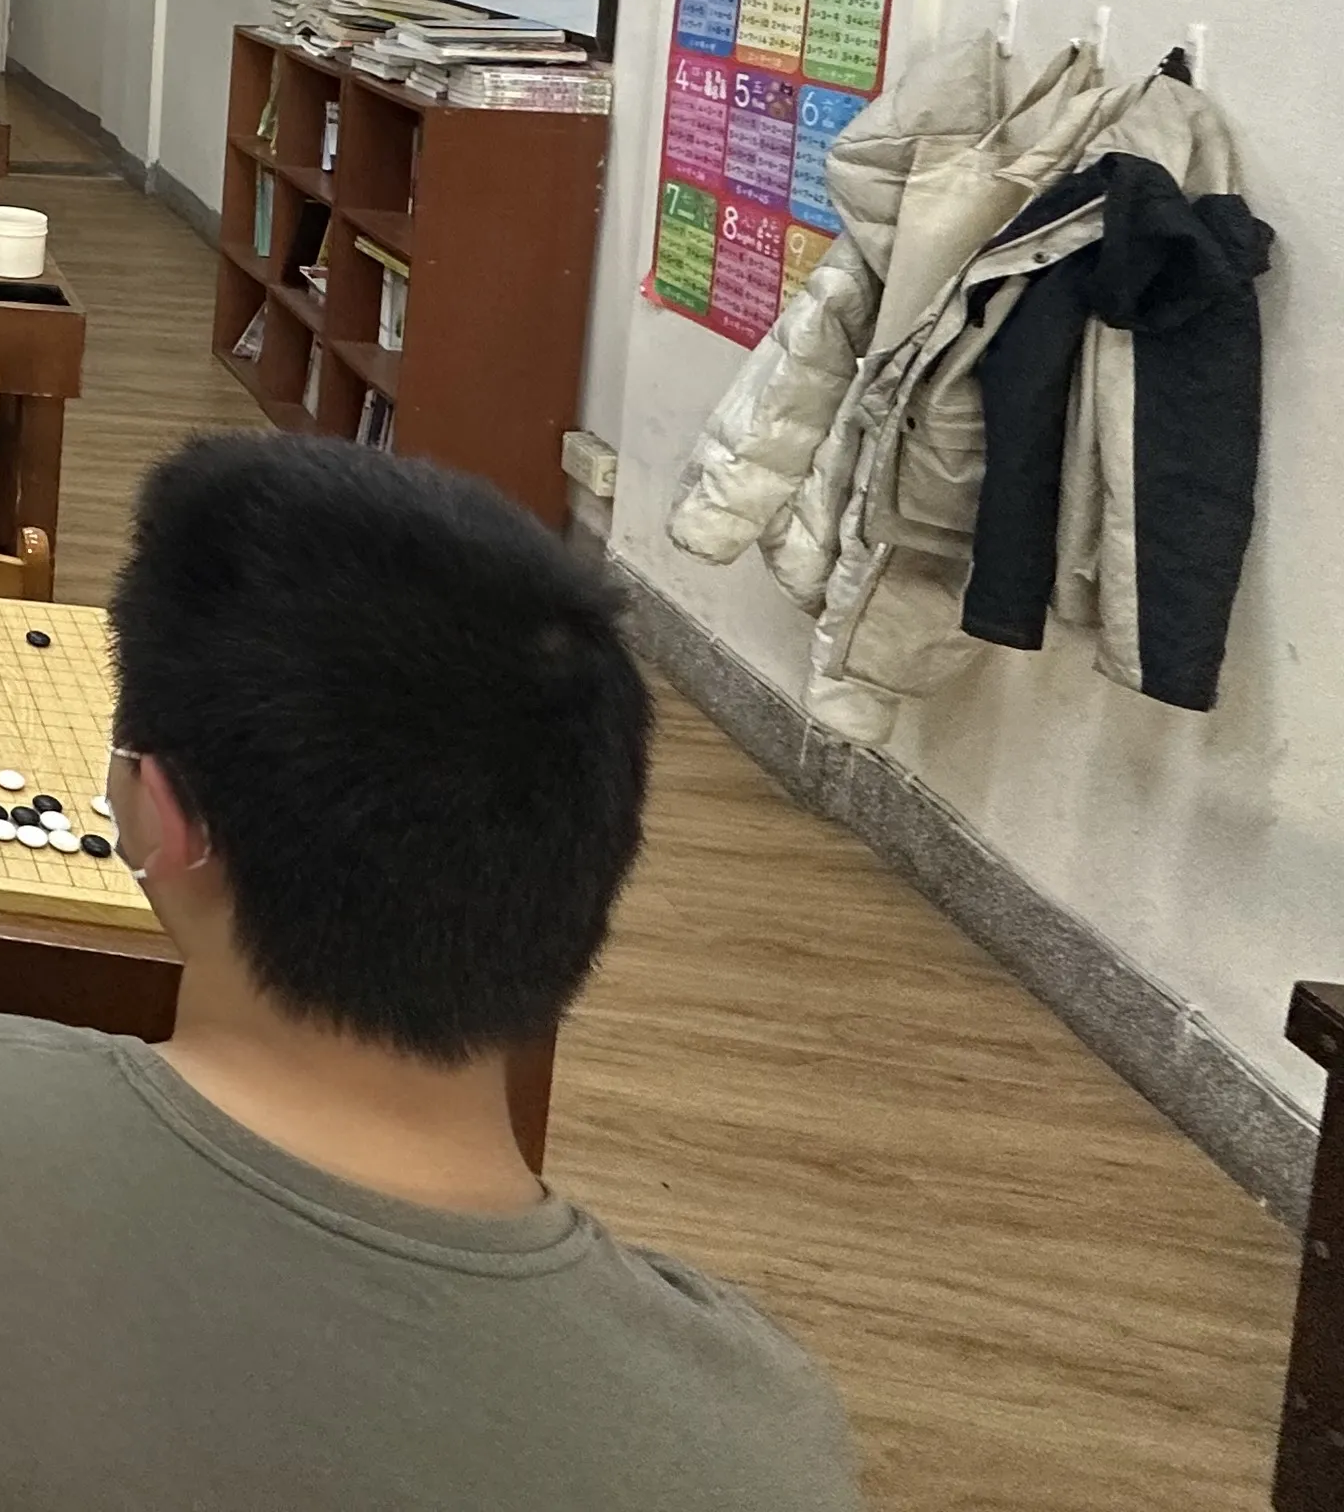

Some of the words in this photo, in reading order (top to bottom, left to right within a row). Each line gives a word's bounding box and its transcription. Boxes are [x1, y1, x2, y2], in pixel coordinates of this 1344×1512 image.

[675, 58, 690, 91] 4
[734, 73, 750, 107] 5
[802, 91, 818, 126] 6
[667, 183, 680, 216] 7
[723, 206, 738, 240] 8
